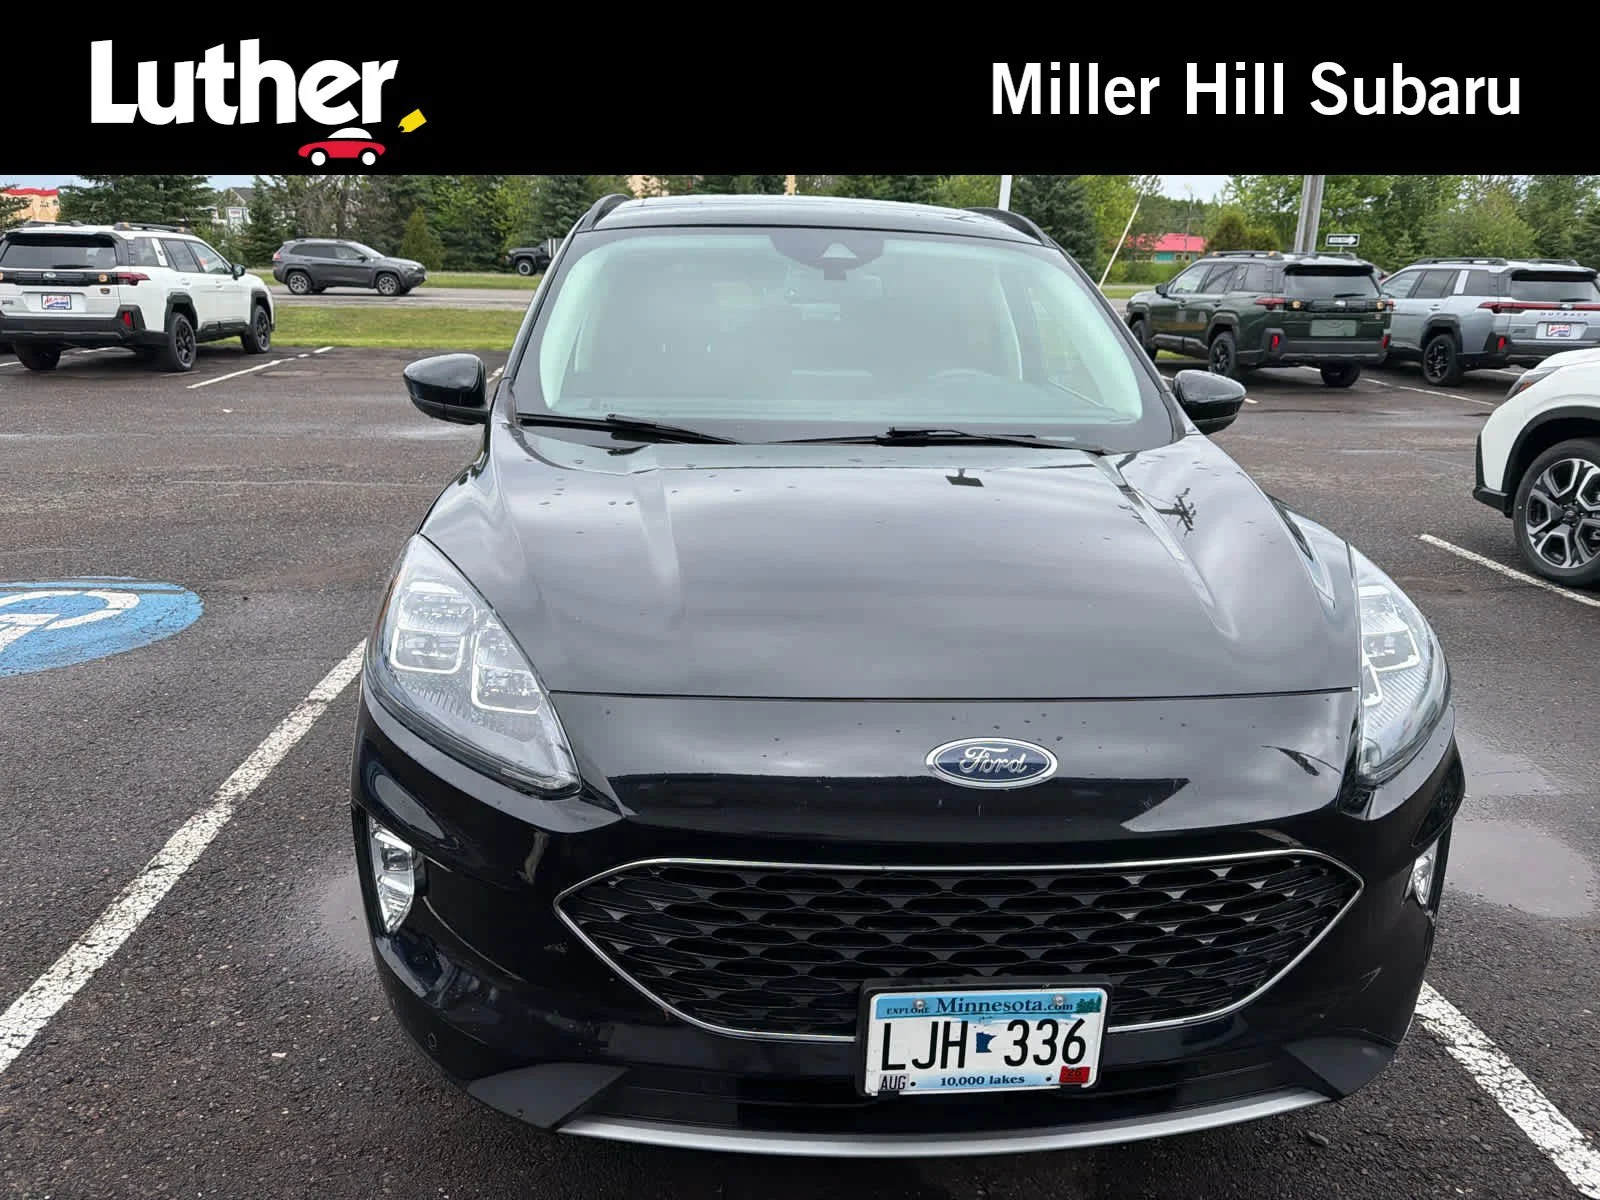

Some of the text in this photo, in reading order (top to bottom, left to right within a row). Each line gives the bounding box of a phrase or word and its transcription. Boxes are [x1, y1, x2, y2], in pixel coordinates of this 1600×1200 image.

[959, 746, 1028, 774] Ford
[881, 1018, 1086, 1071] LJH 336
[880, 1075, 906, 1090] AUG
[940, 1075, 1025, 1087] 10,000 lakes
